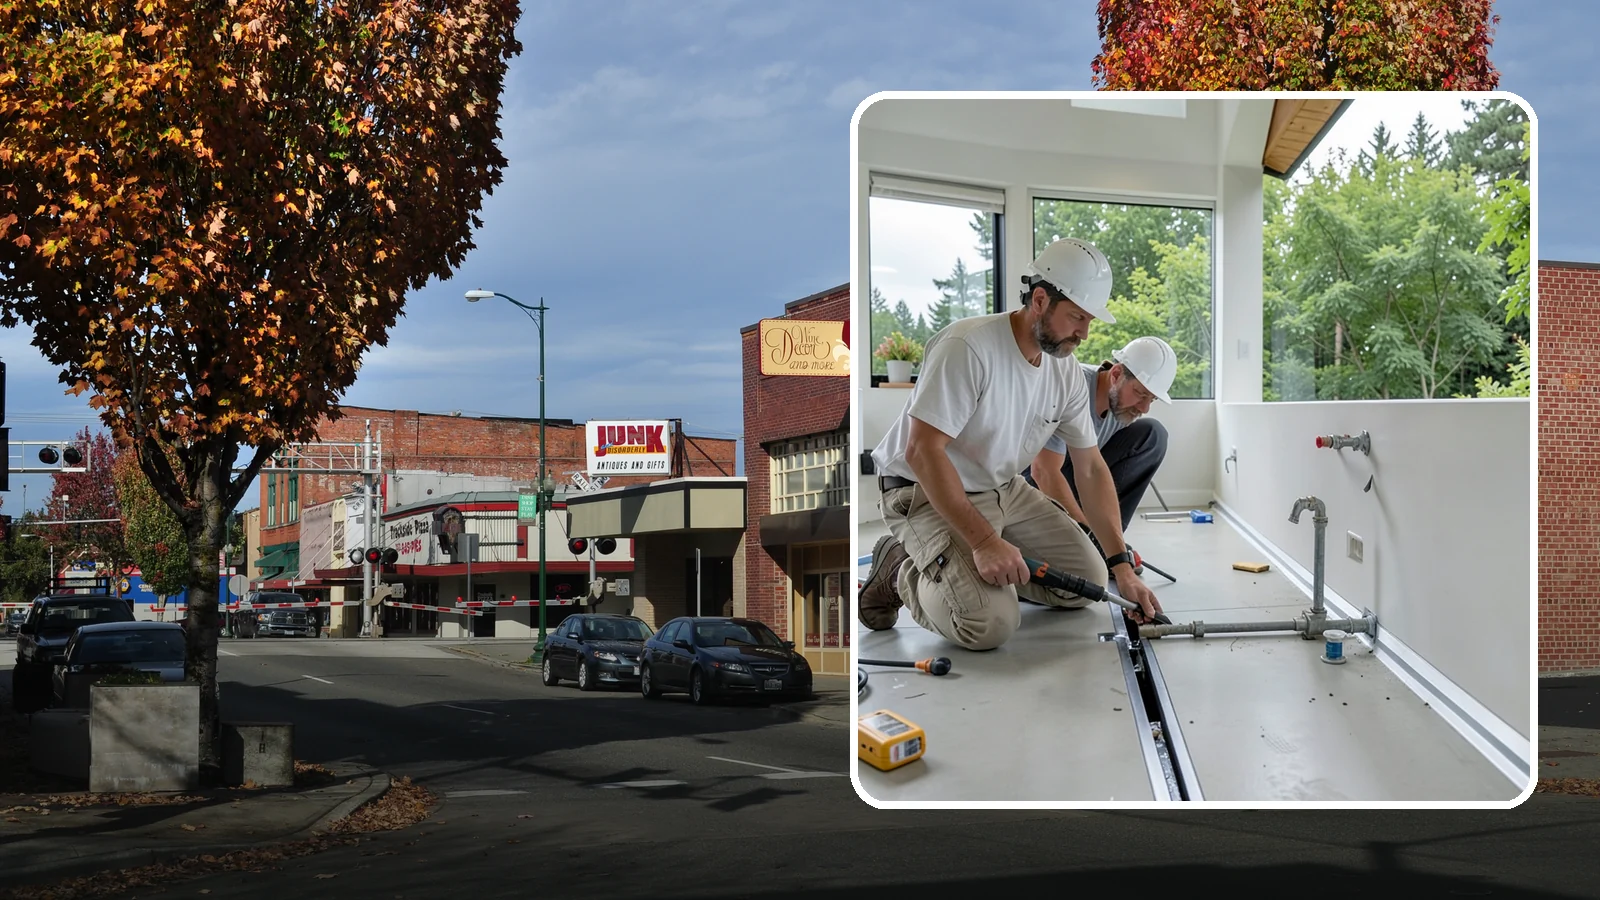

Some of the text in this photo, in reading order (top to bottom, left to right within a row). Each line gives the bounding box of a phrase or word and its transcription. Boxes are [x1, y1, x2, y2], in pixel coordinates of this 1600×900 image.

[791, 325, 823, 345] Wine
[765, 328, 830, 365] Decor
[595, 425, 666, 457] JUNK
[607, 446, 646, 454] DISORDERLY
[597, 460, 665, 470] ANTIQUES AND GIFTS
[415, 520, 429, 534] Pizza
